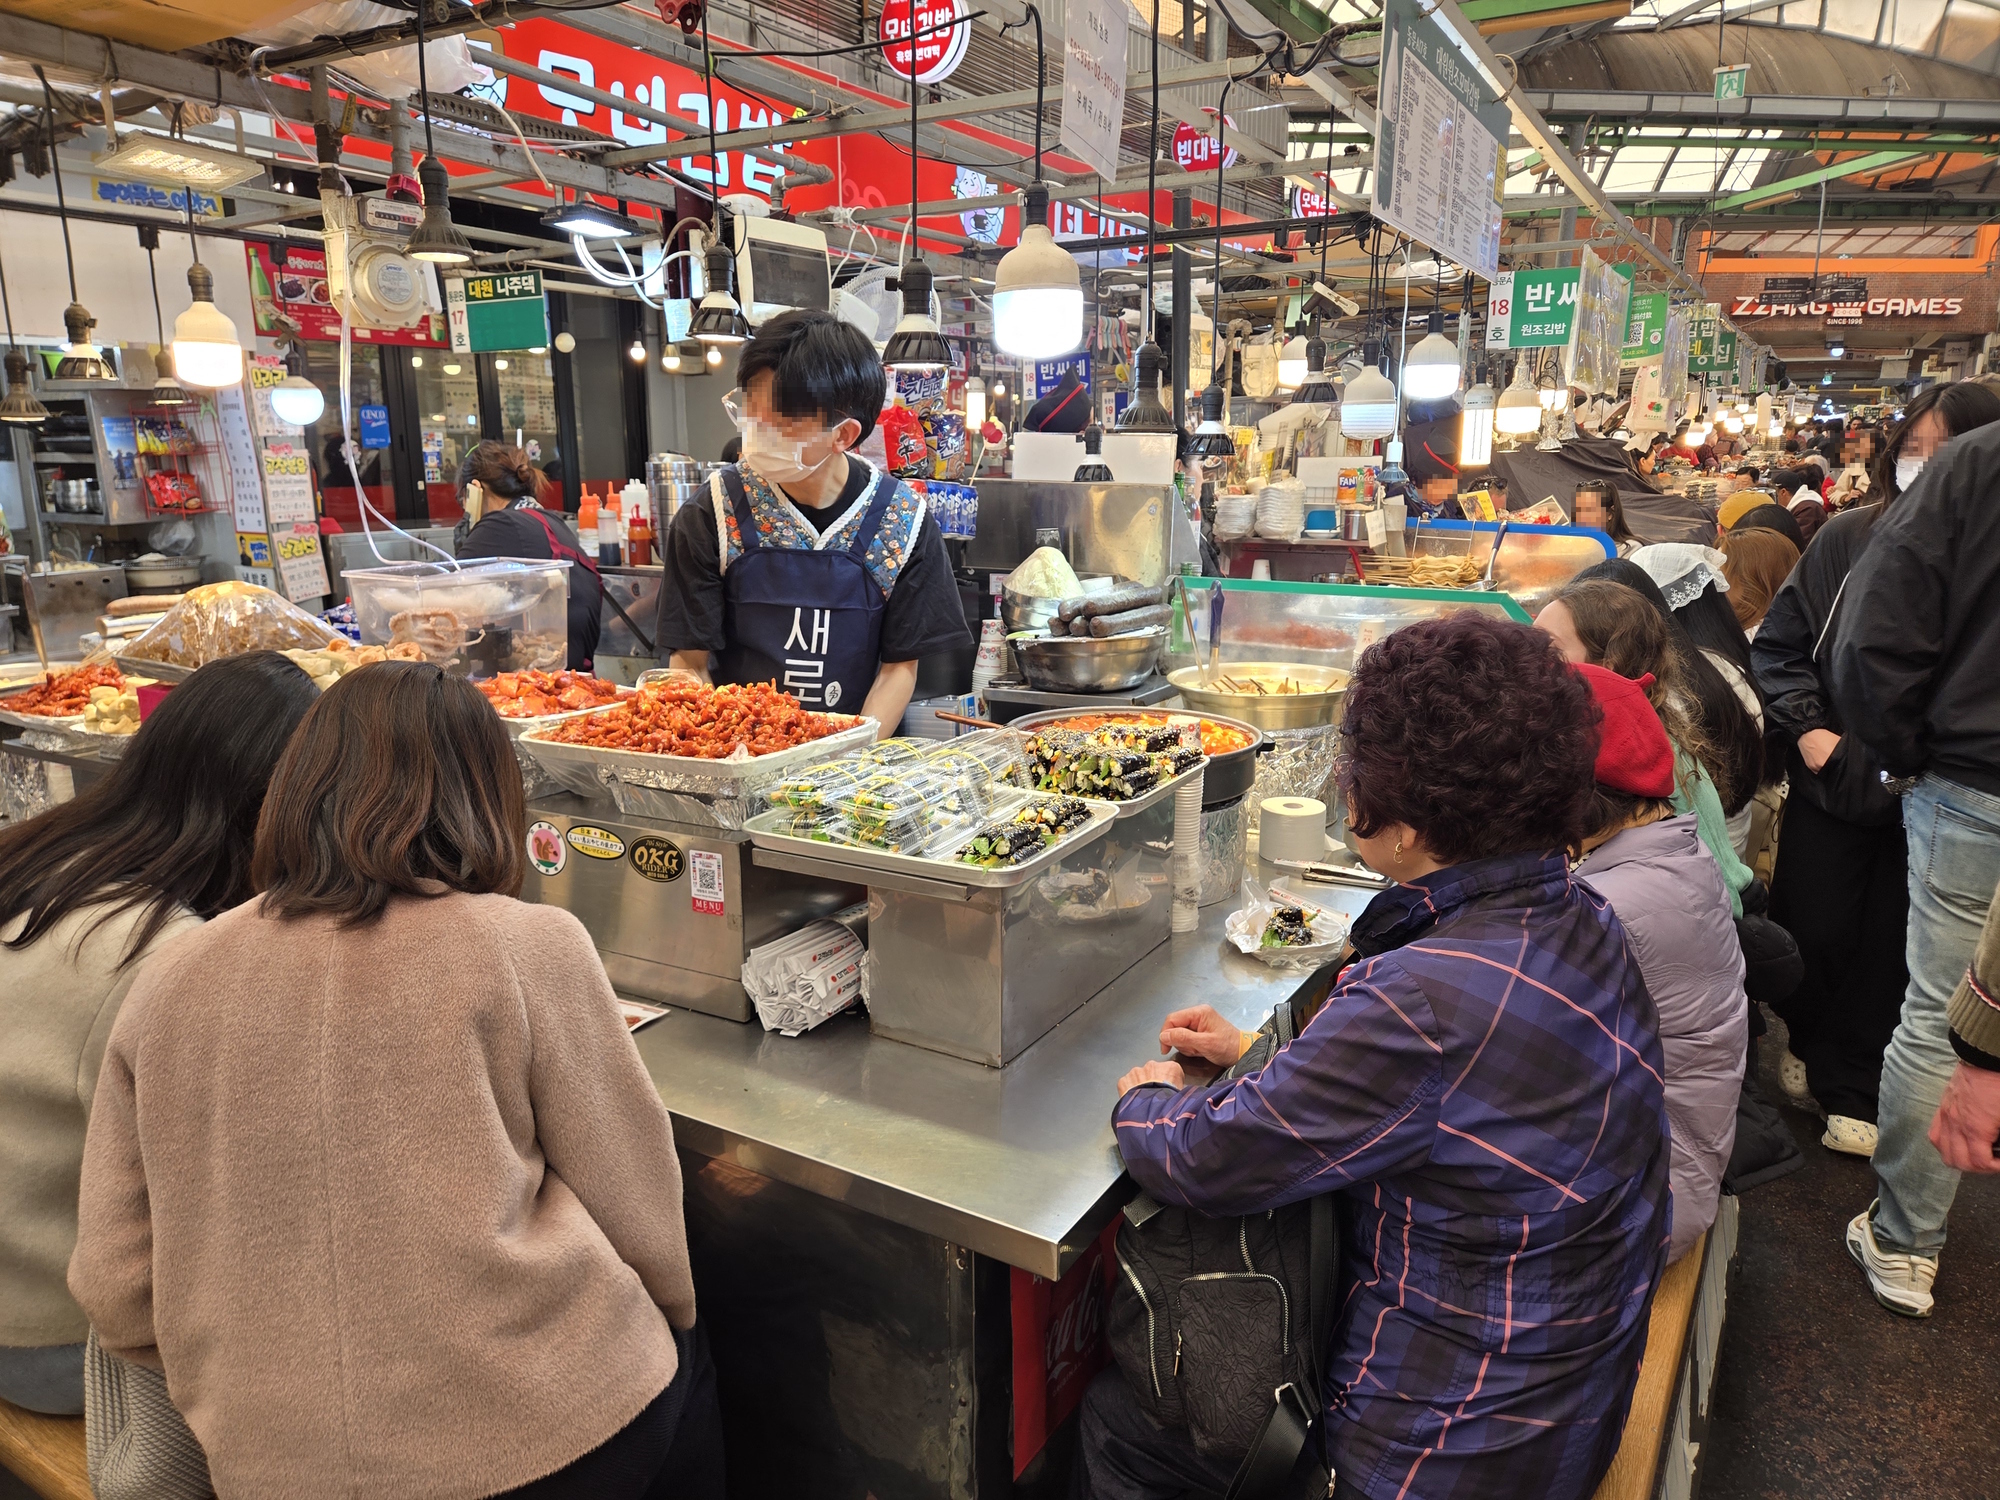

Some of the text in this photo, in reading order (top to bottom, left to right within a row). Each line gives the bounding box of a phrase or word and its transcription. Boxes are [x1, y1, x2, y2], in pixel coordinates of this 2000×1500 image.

[468, 274, 535, 299] 대원 나주댁
[1490, 298, 1510, 316] 18
[1867, 297, 1964, 318] GAMES
[451, 310, 464, 325] 17
[1488, 326, 1506, 343] 호
[1520, 322, 1567, 337] 원조김밥
[455, 332, 467, 347] 호
[1025, 373, 1035, 383] 18
[1105, 405, 1114, 415] 19
[634, 845, 679, 871] OKG
[641, 863, 676, 874] RIDER'S
[695, 899, 721, 911] MENU
